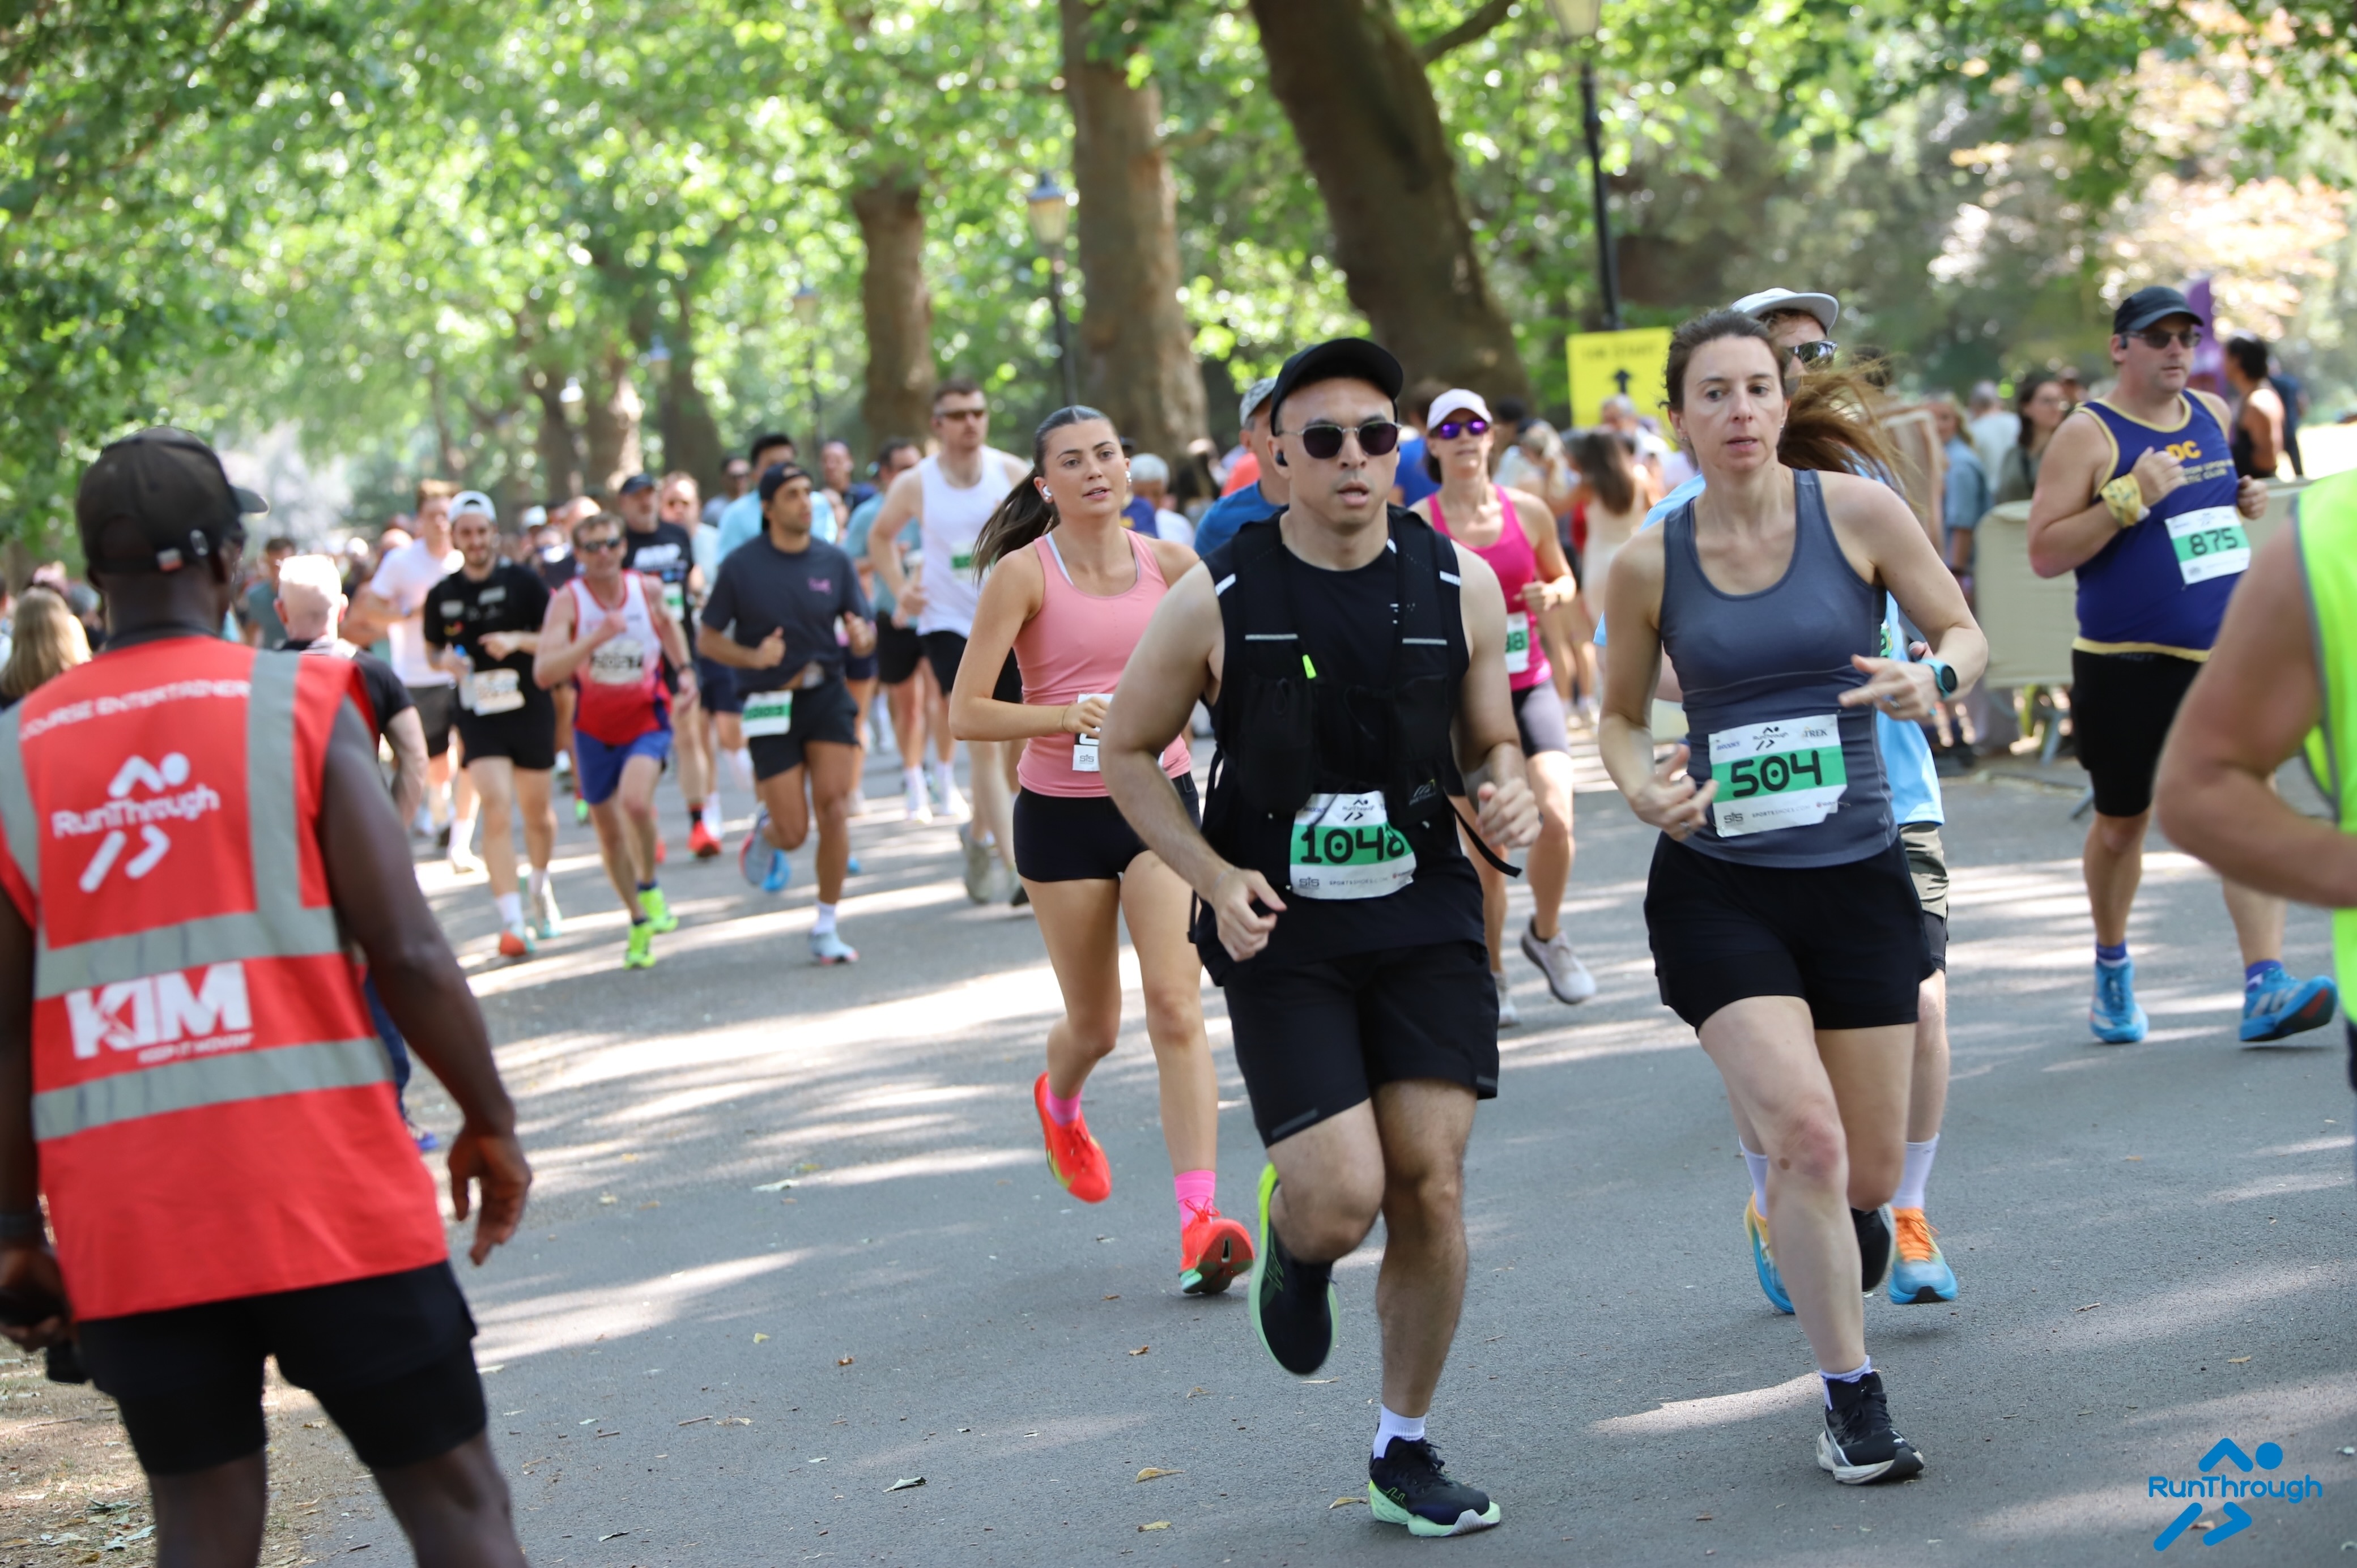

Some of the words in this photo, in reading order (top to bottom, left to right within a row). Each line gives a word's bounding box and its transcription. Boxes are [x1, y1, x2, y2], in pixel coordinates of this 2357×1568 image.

[2189, 527, 2237, 556] 875
[1802, 728, 1829, 738] TREK
[1731, 750, 1822, 797] 504
[51, 783, 221, 838] RunThrough
[64, 961, 253, 1059] KIM
